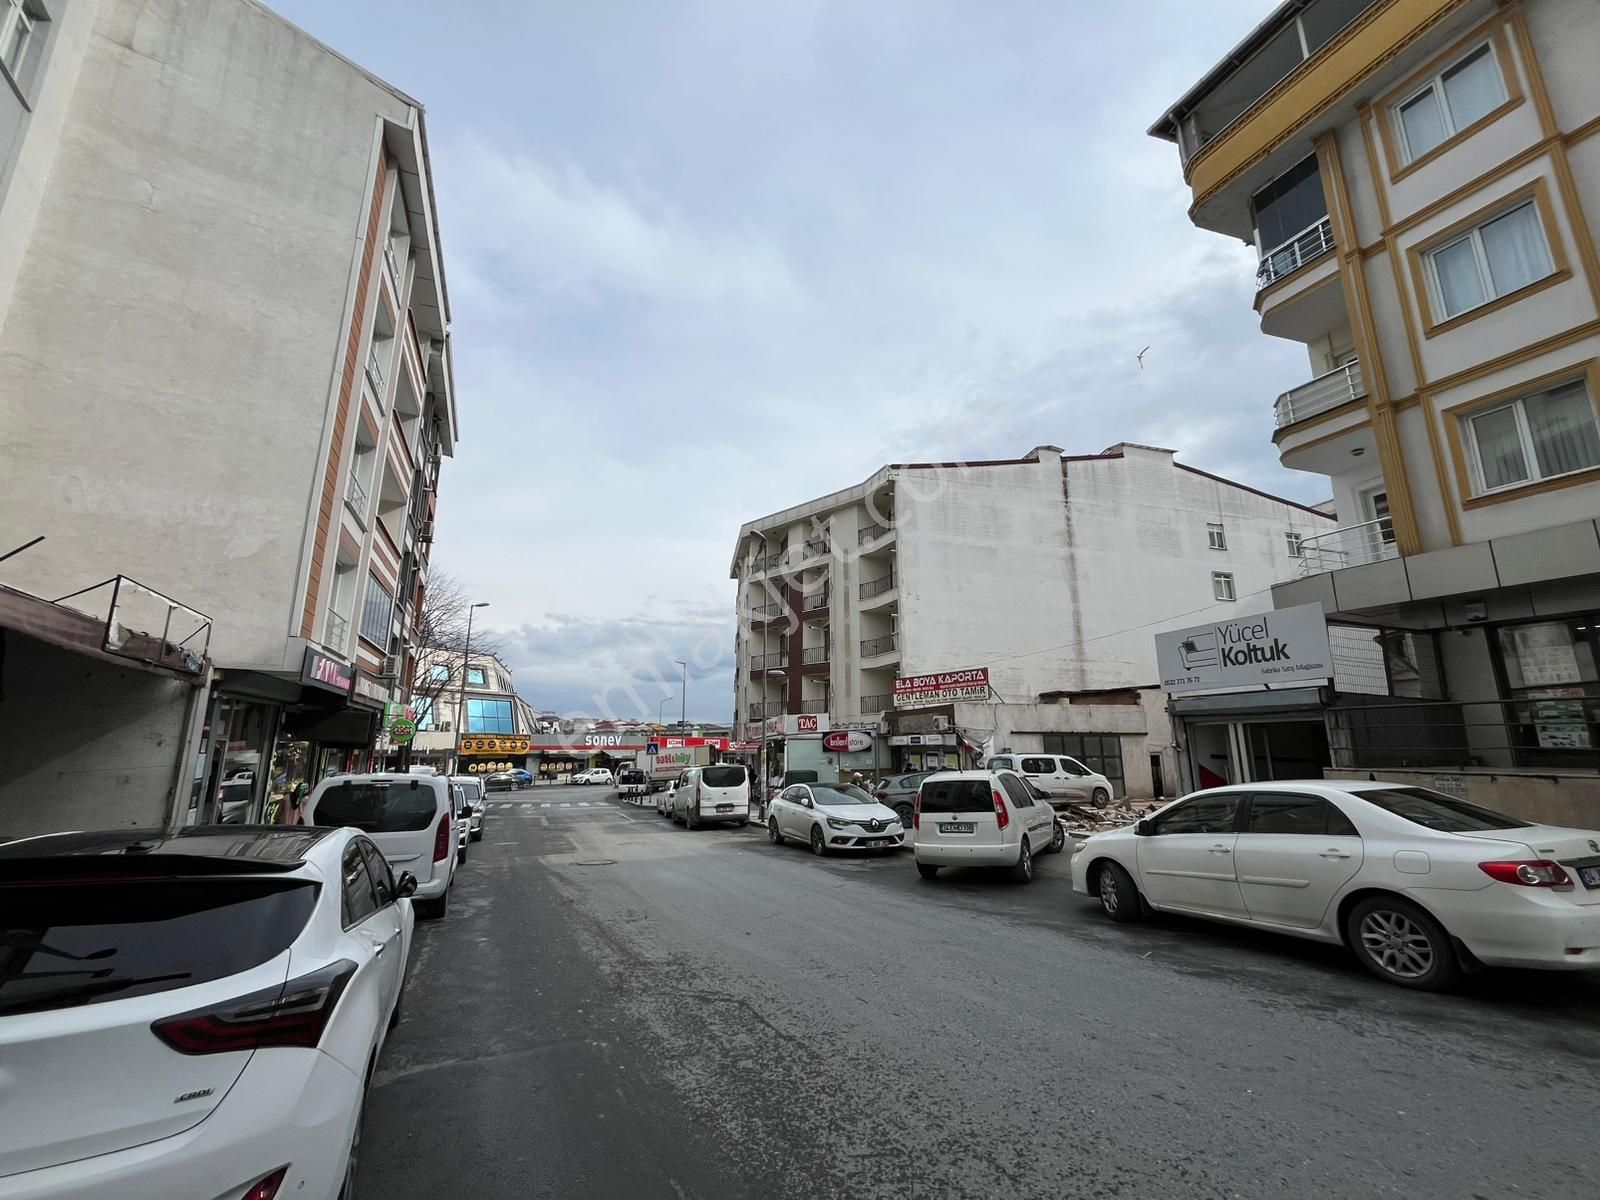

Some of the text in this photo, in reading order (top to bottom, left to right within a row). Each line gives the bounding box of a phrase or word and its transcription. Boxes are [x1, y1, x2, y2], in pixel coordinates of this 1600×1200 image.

[1217, 616, 1269, 645] Yücel
[1221, 638, 1290, 667] Koltuk
[895, 680, 911, 689] ELA
[913, 676, 937, 687] BOYA
[938, 670, 985, 684] KAPORTA
[896, 690, 940, 702] GENTLEMAN
[942, 688, 958, 698] OTO
[798, 719, 817, 730] TAÇ
[849, 738, 864, 746] store
